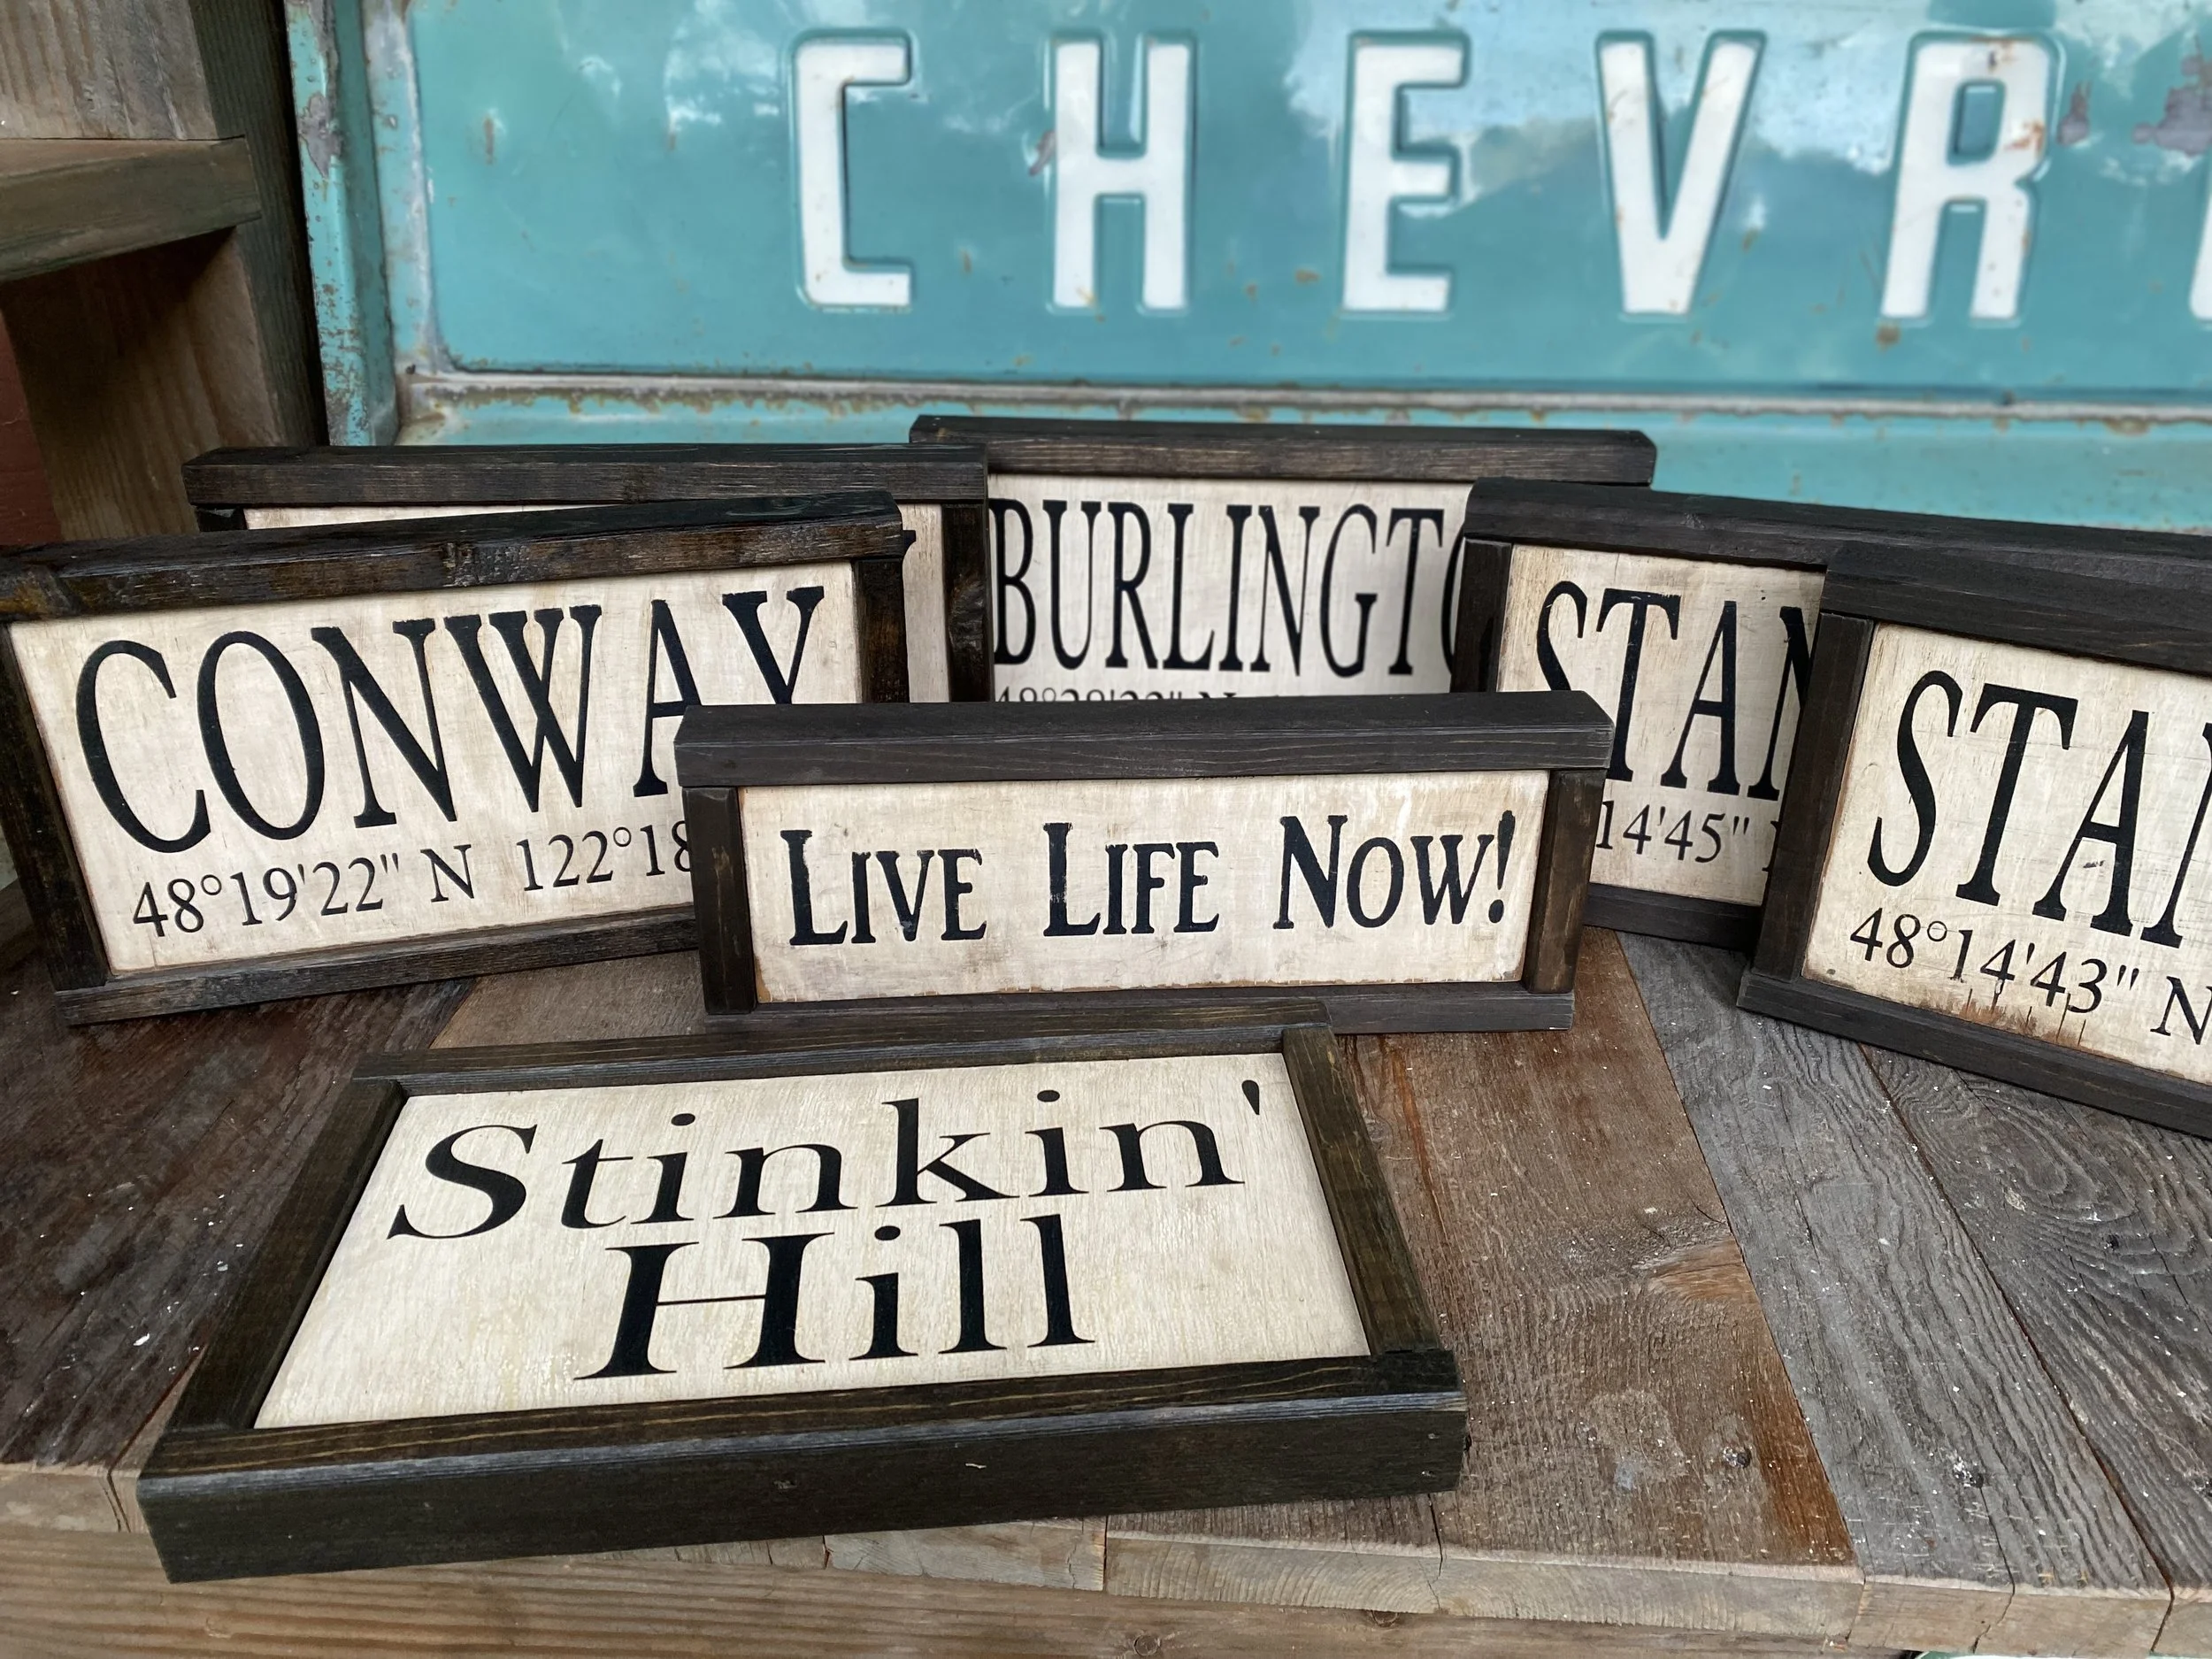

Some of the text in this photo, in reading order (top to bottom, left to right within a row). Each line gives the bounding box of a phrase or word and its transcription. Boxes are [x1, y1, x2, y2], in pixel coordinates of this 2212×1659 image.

[797, 35, 2212, 322] CHEVR
[75, 586, 825, 854] CONWAY
[419, 843, 476, 903] N
[780, 809, 1516, 946] LIVE LIFE NOW!
[2149, 975, 2212, 1046] N
[387, 1079, 1262, 1241] Stinkin'
[572, 1213, 1097, 1381] Hill
